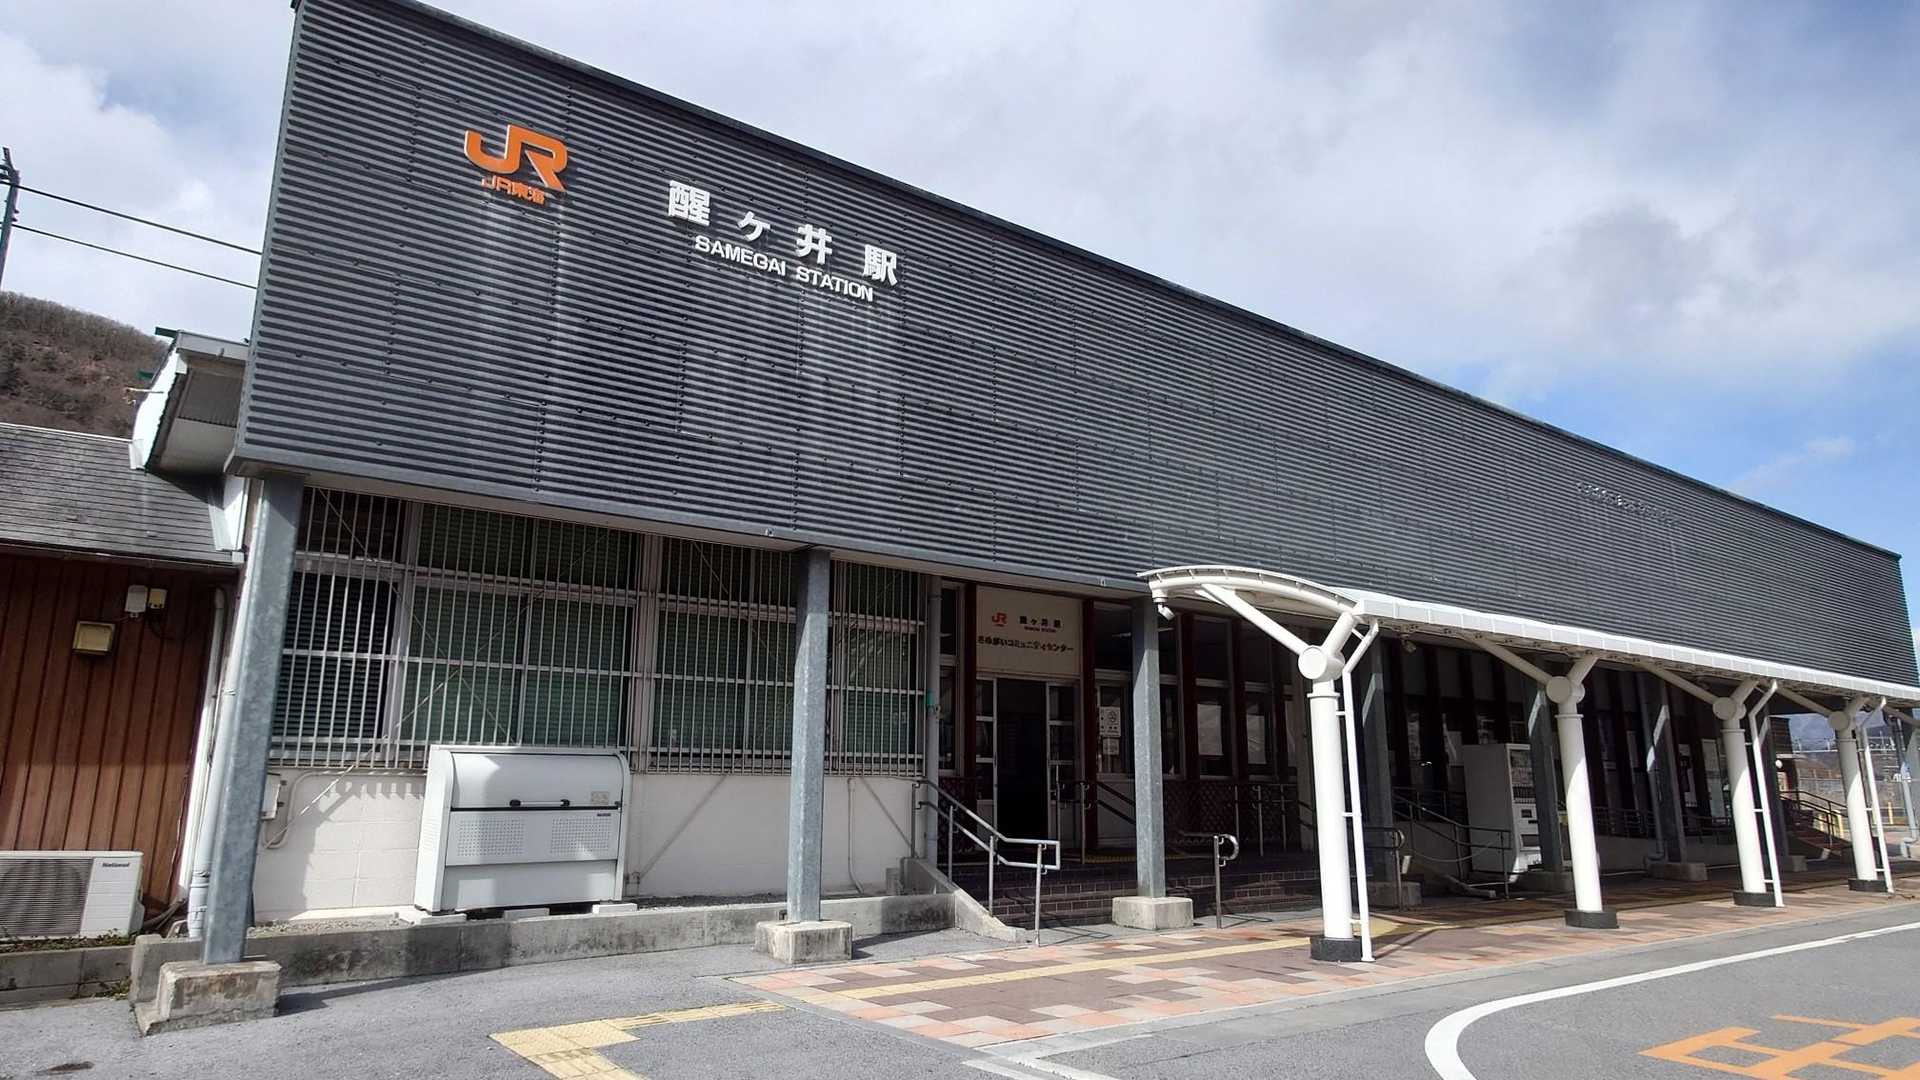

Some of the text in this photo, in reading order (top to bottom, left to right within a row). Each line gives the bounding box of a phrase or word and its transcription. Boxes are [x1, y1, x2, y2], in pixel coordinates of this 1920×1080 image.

[464, 124, 568, 192] JR
[694, 234, 874, 302] SAMEGAI STATION
